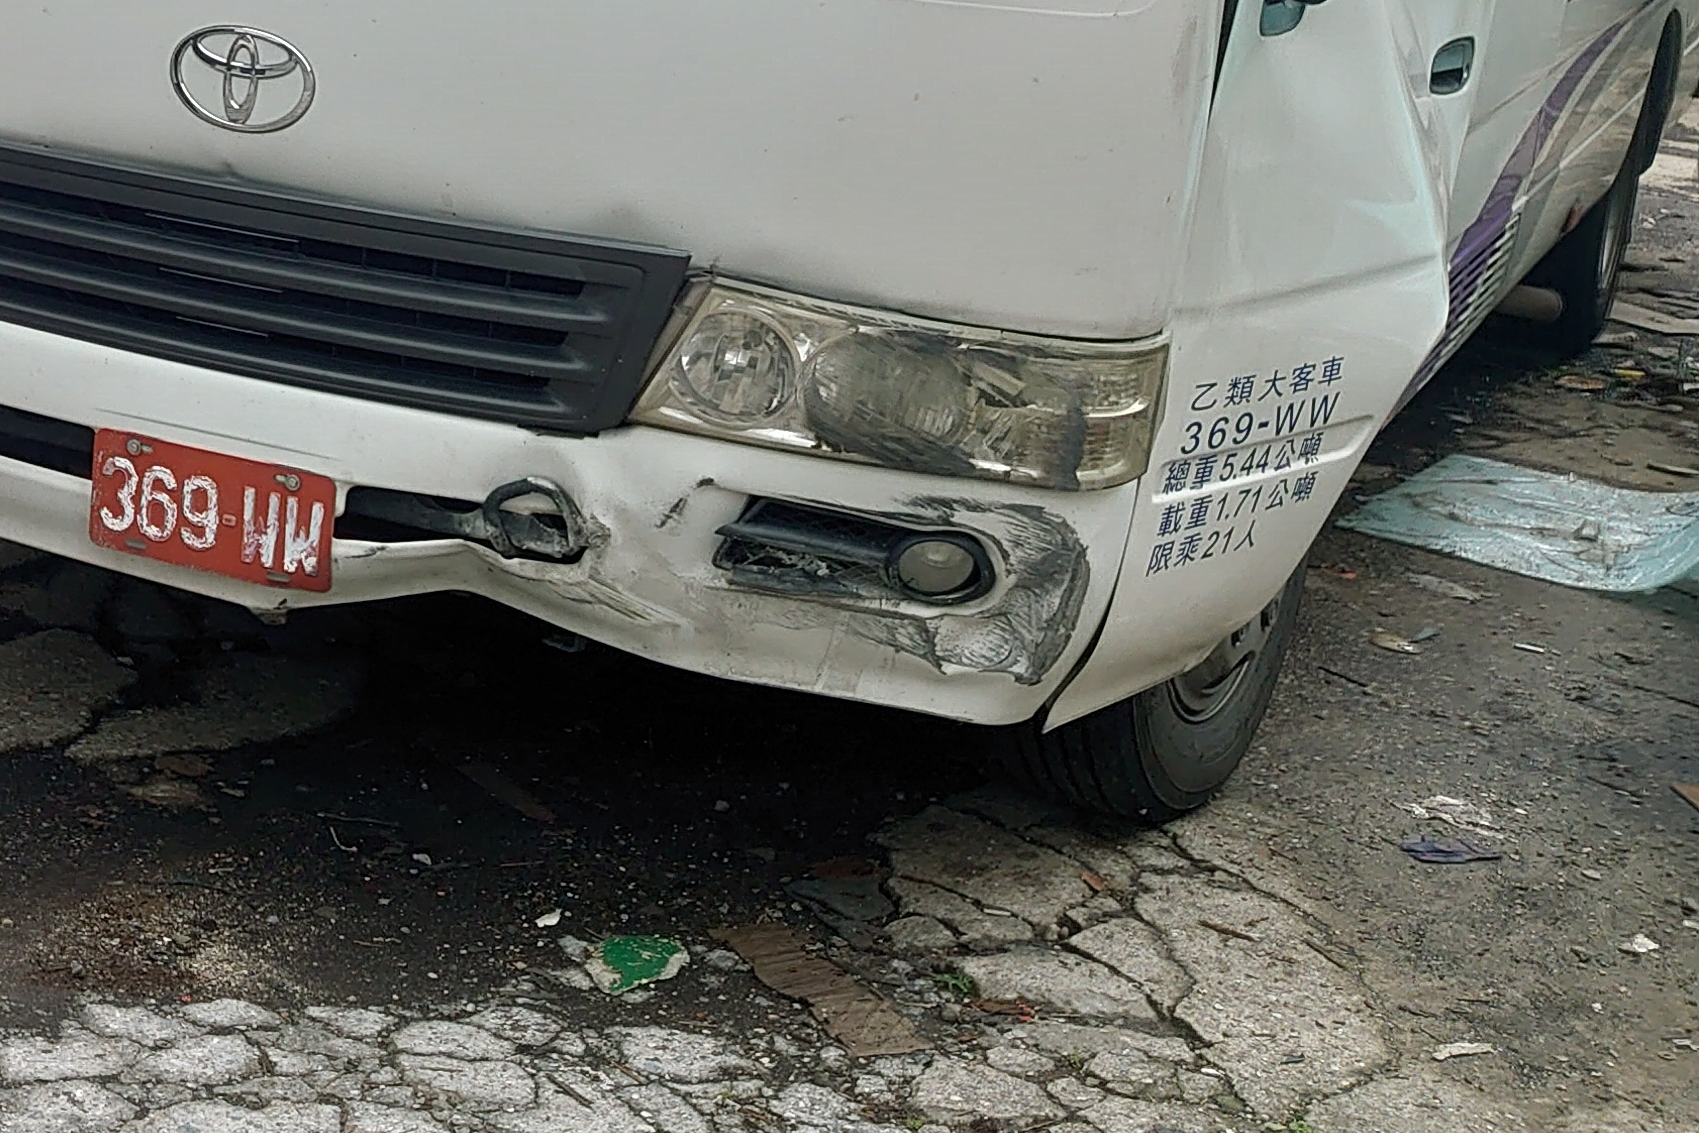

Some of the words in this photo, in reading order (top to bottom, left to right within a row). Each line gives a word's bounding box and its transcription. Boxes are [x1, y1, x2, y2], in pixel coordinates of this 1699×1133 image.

[1190, 356, 1345, 413] 乙類大客車
[1180, 392, 1341, 455] 369-WW
[100, 455, 324, 576] 369-WW
[1145, 519, 1256, 577] 限乘21人
